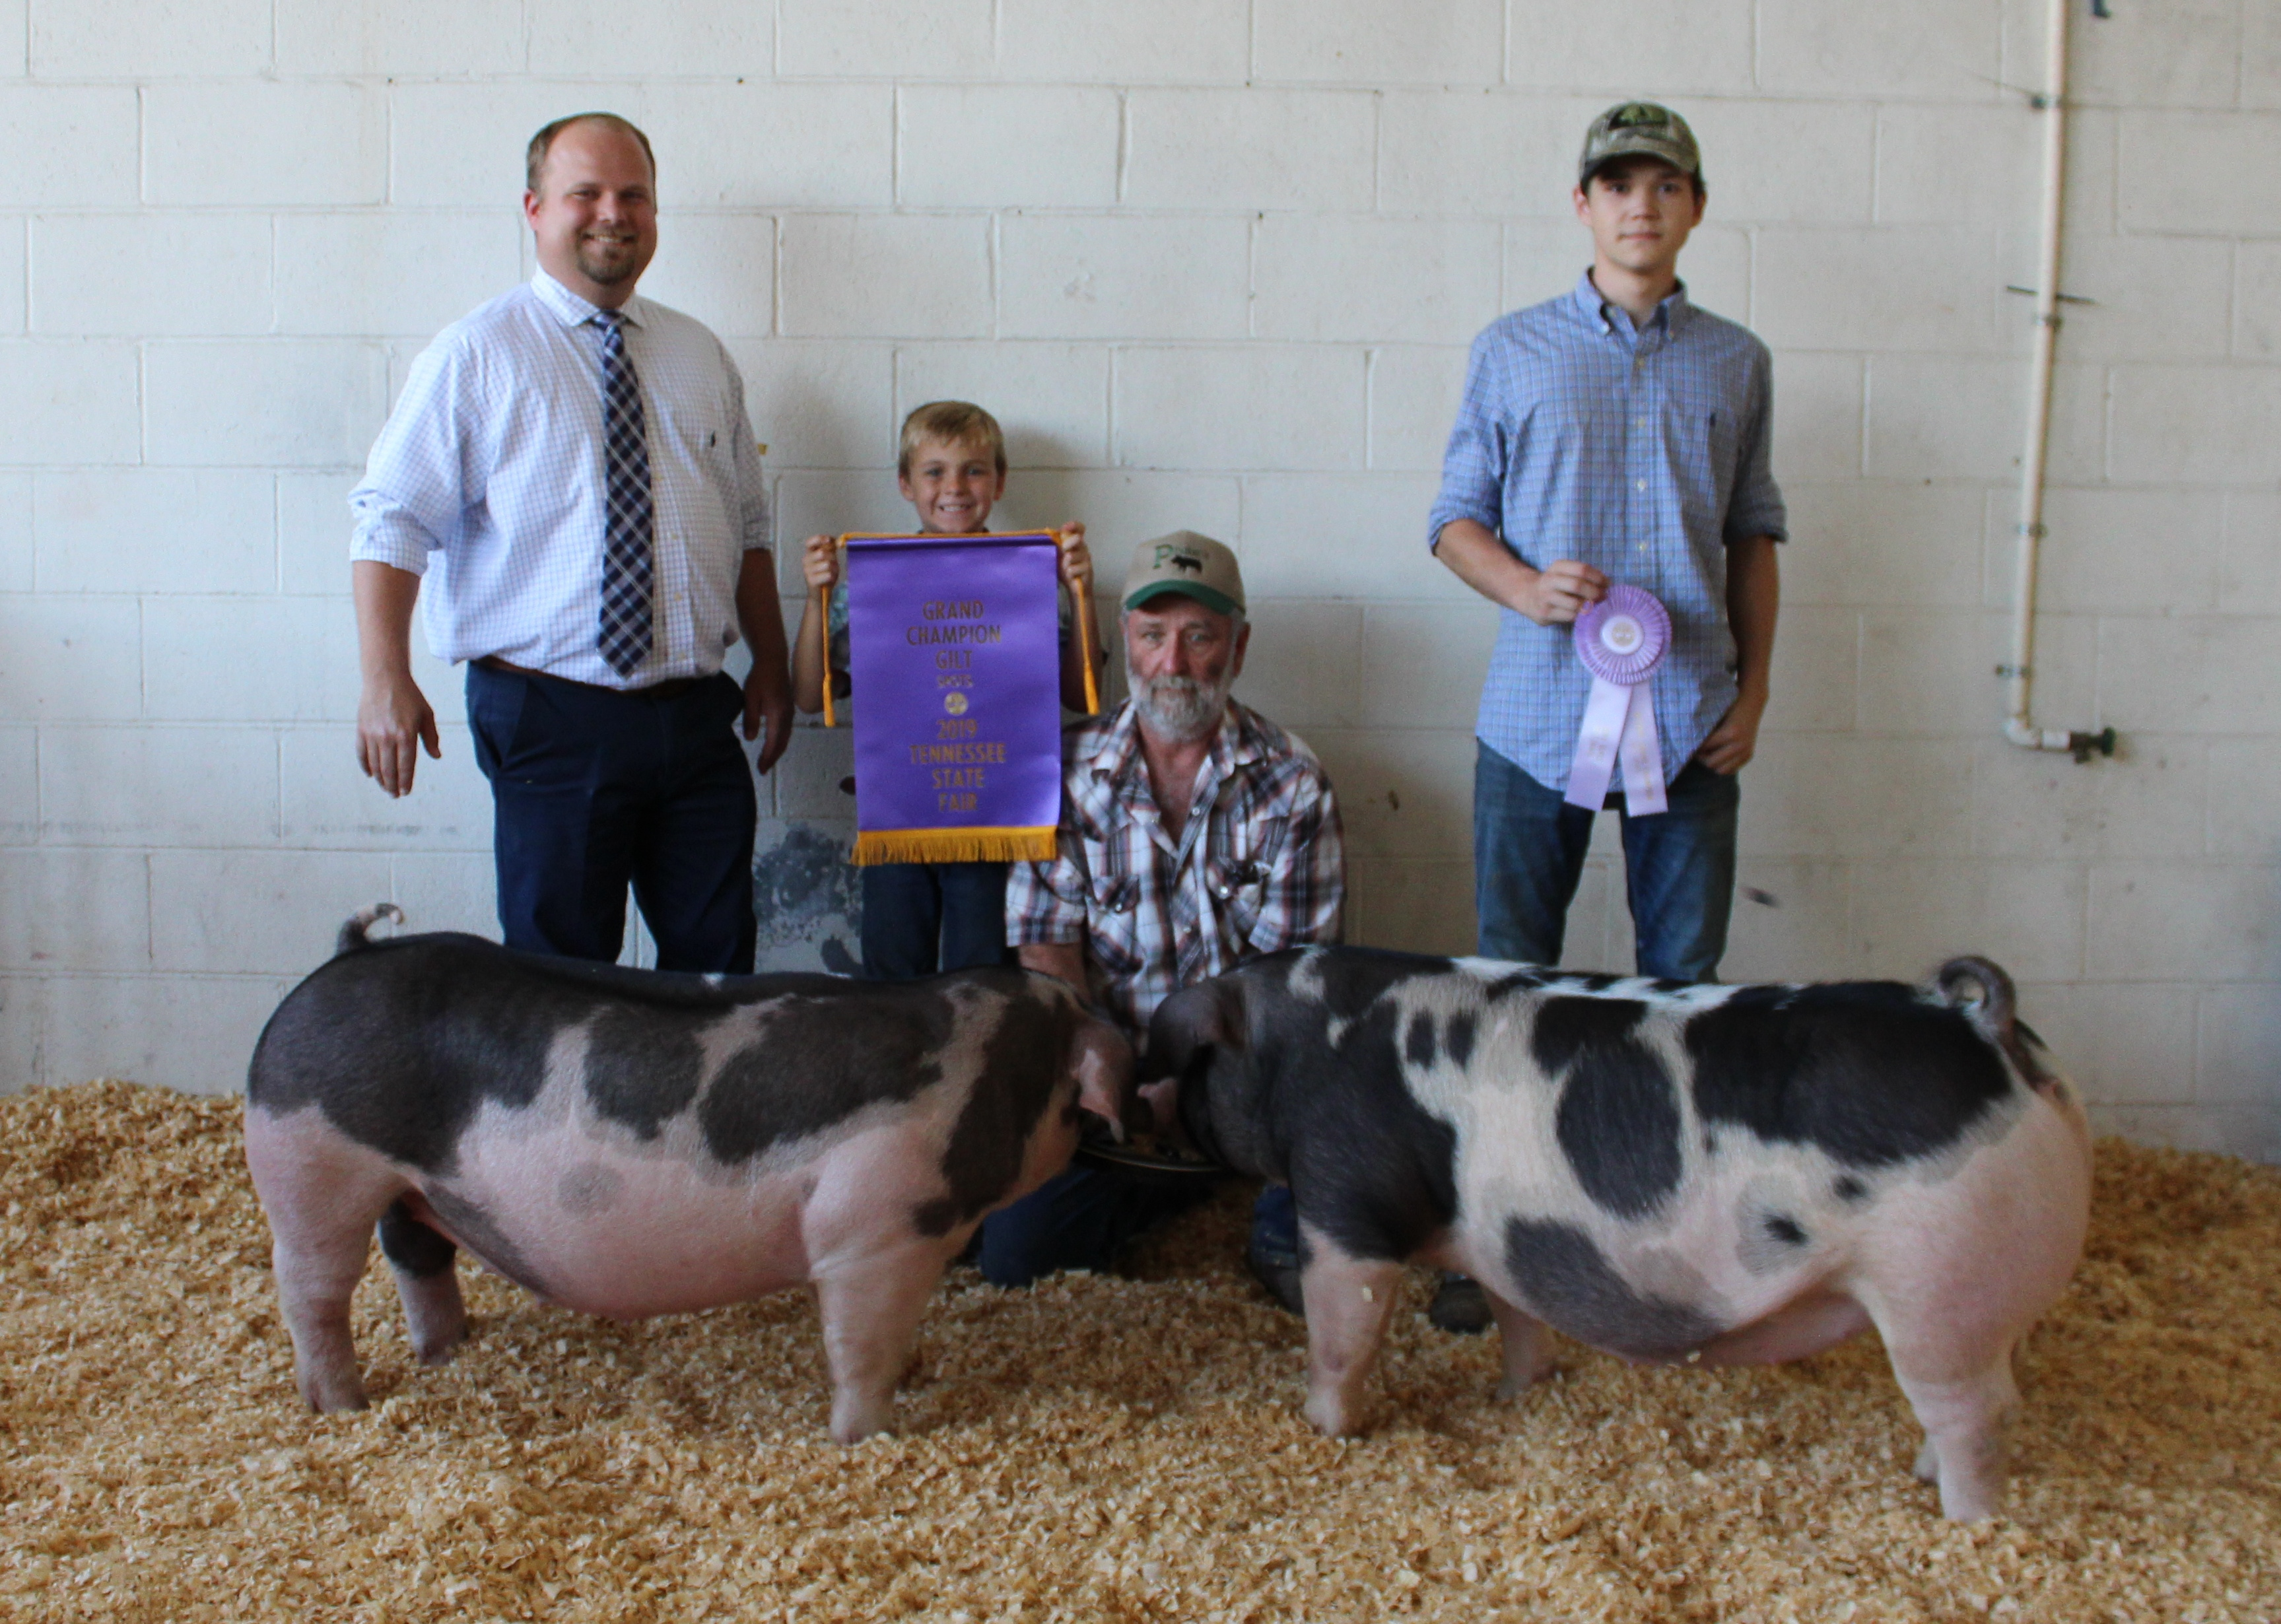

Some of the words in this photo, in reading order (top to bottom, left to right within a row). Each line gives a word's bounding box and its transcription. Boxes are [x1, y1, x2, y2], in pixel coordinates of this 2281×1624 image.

[922, 600, 984, 621] GRAND
[906, 625, 1002, 646] CHAMPION
[936, 650, 973, 669] GILT
[936, 720, 978, 739] 2019
[909, 743, 1007, 764] TENNESSEE
[932, 768, 986, 788] STATE
[938, 793, 978, 812] FAIR
